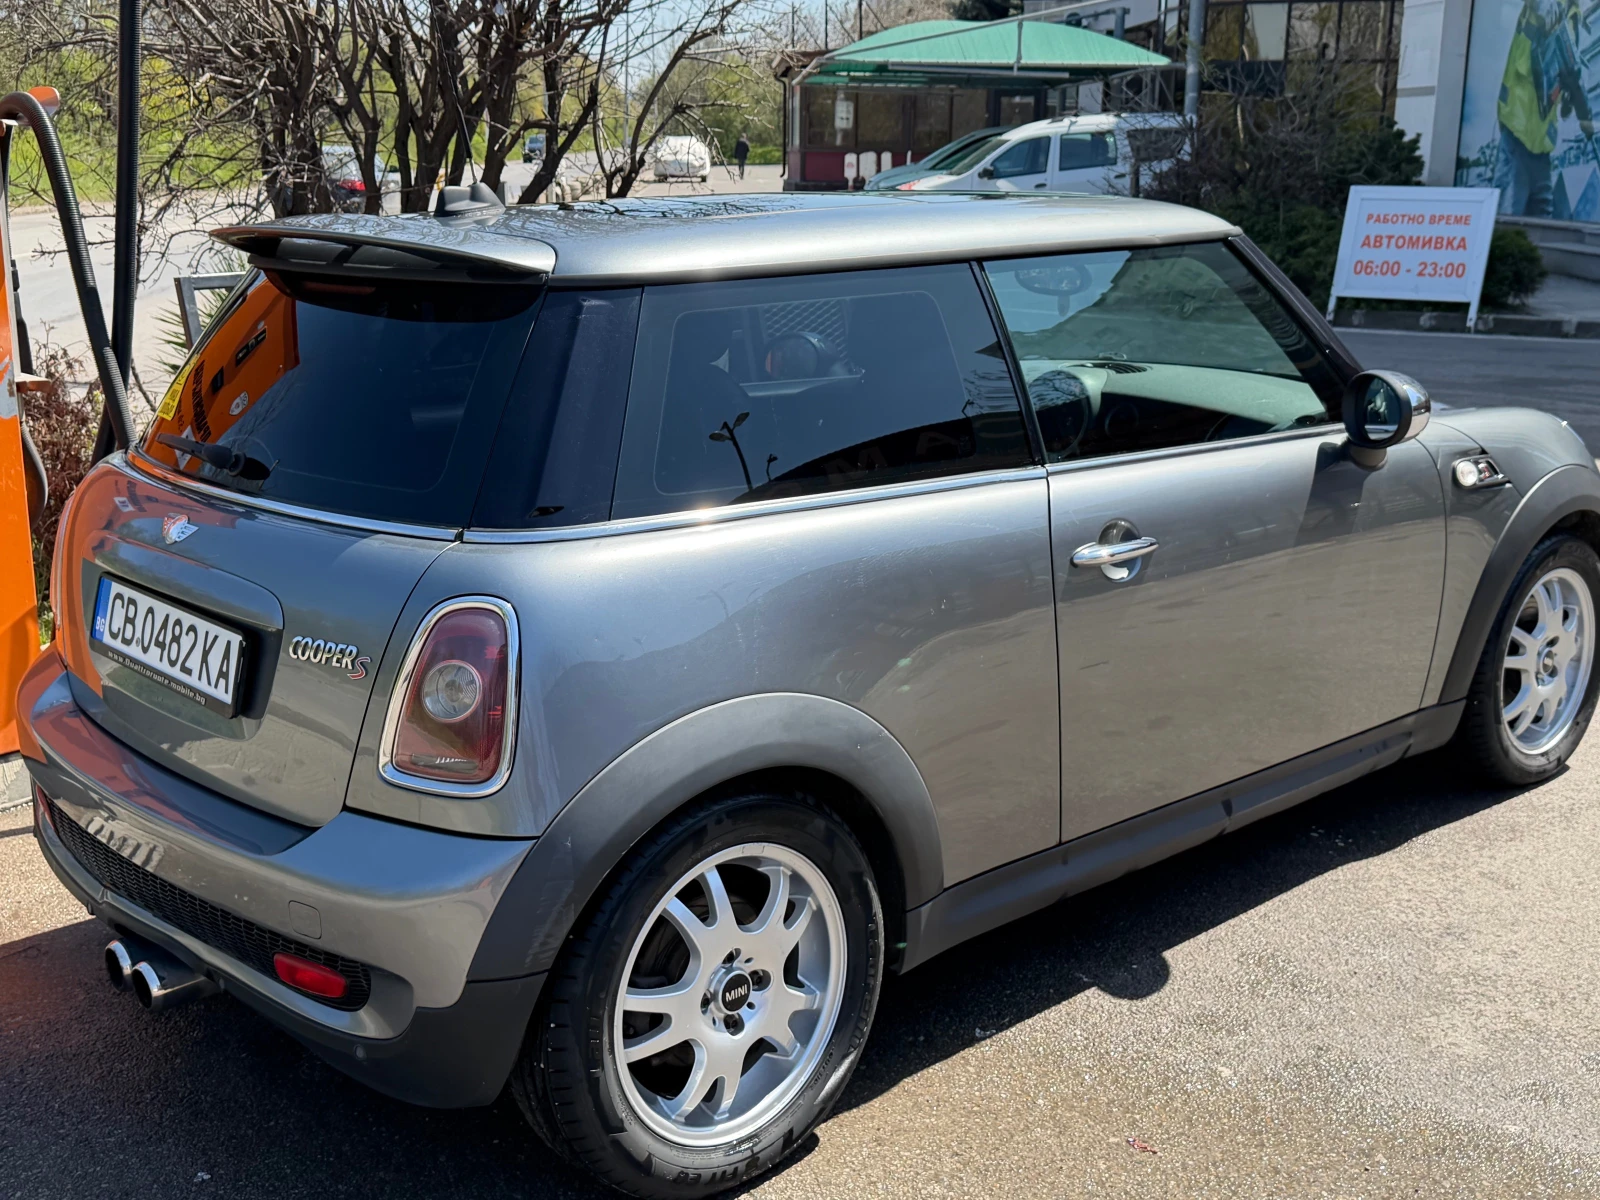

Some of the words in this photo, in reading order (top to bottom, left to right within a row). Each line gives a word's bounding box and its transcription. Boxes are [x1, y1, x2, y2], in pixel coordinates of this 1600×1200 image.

[1366, 213, 1425, 225] РАБОТНО
[1428, 214, 1472, 226] ВРЕМЕ
[1360, 234, 1467, 251] АВТОМИВКА
[1353, 260, 1401, 276] 06:00
[1416, 261, 1466, 279] 23:00
[95, 616, 105, 632] BG
[288, 635, 358, 670] COOPER
[346, 656, 371, 680] S
[725, 984, 748, 1002] MINI
